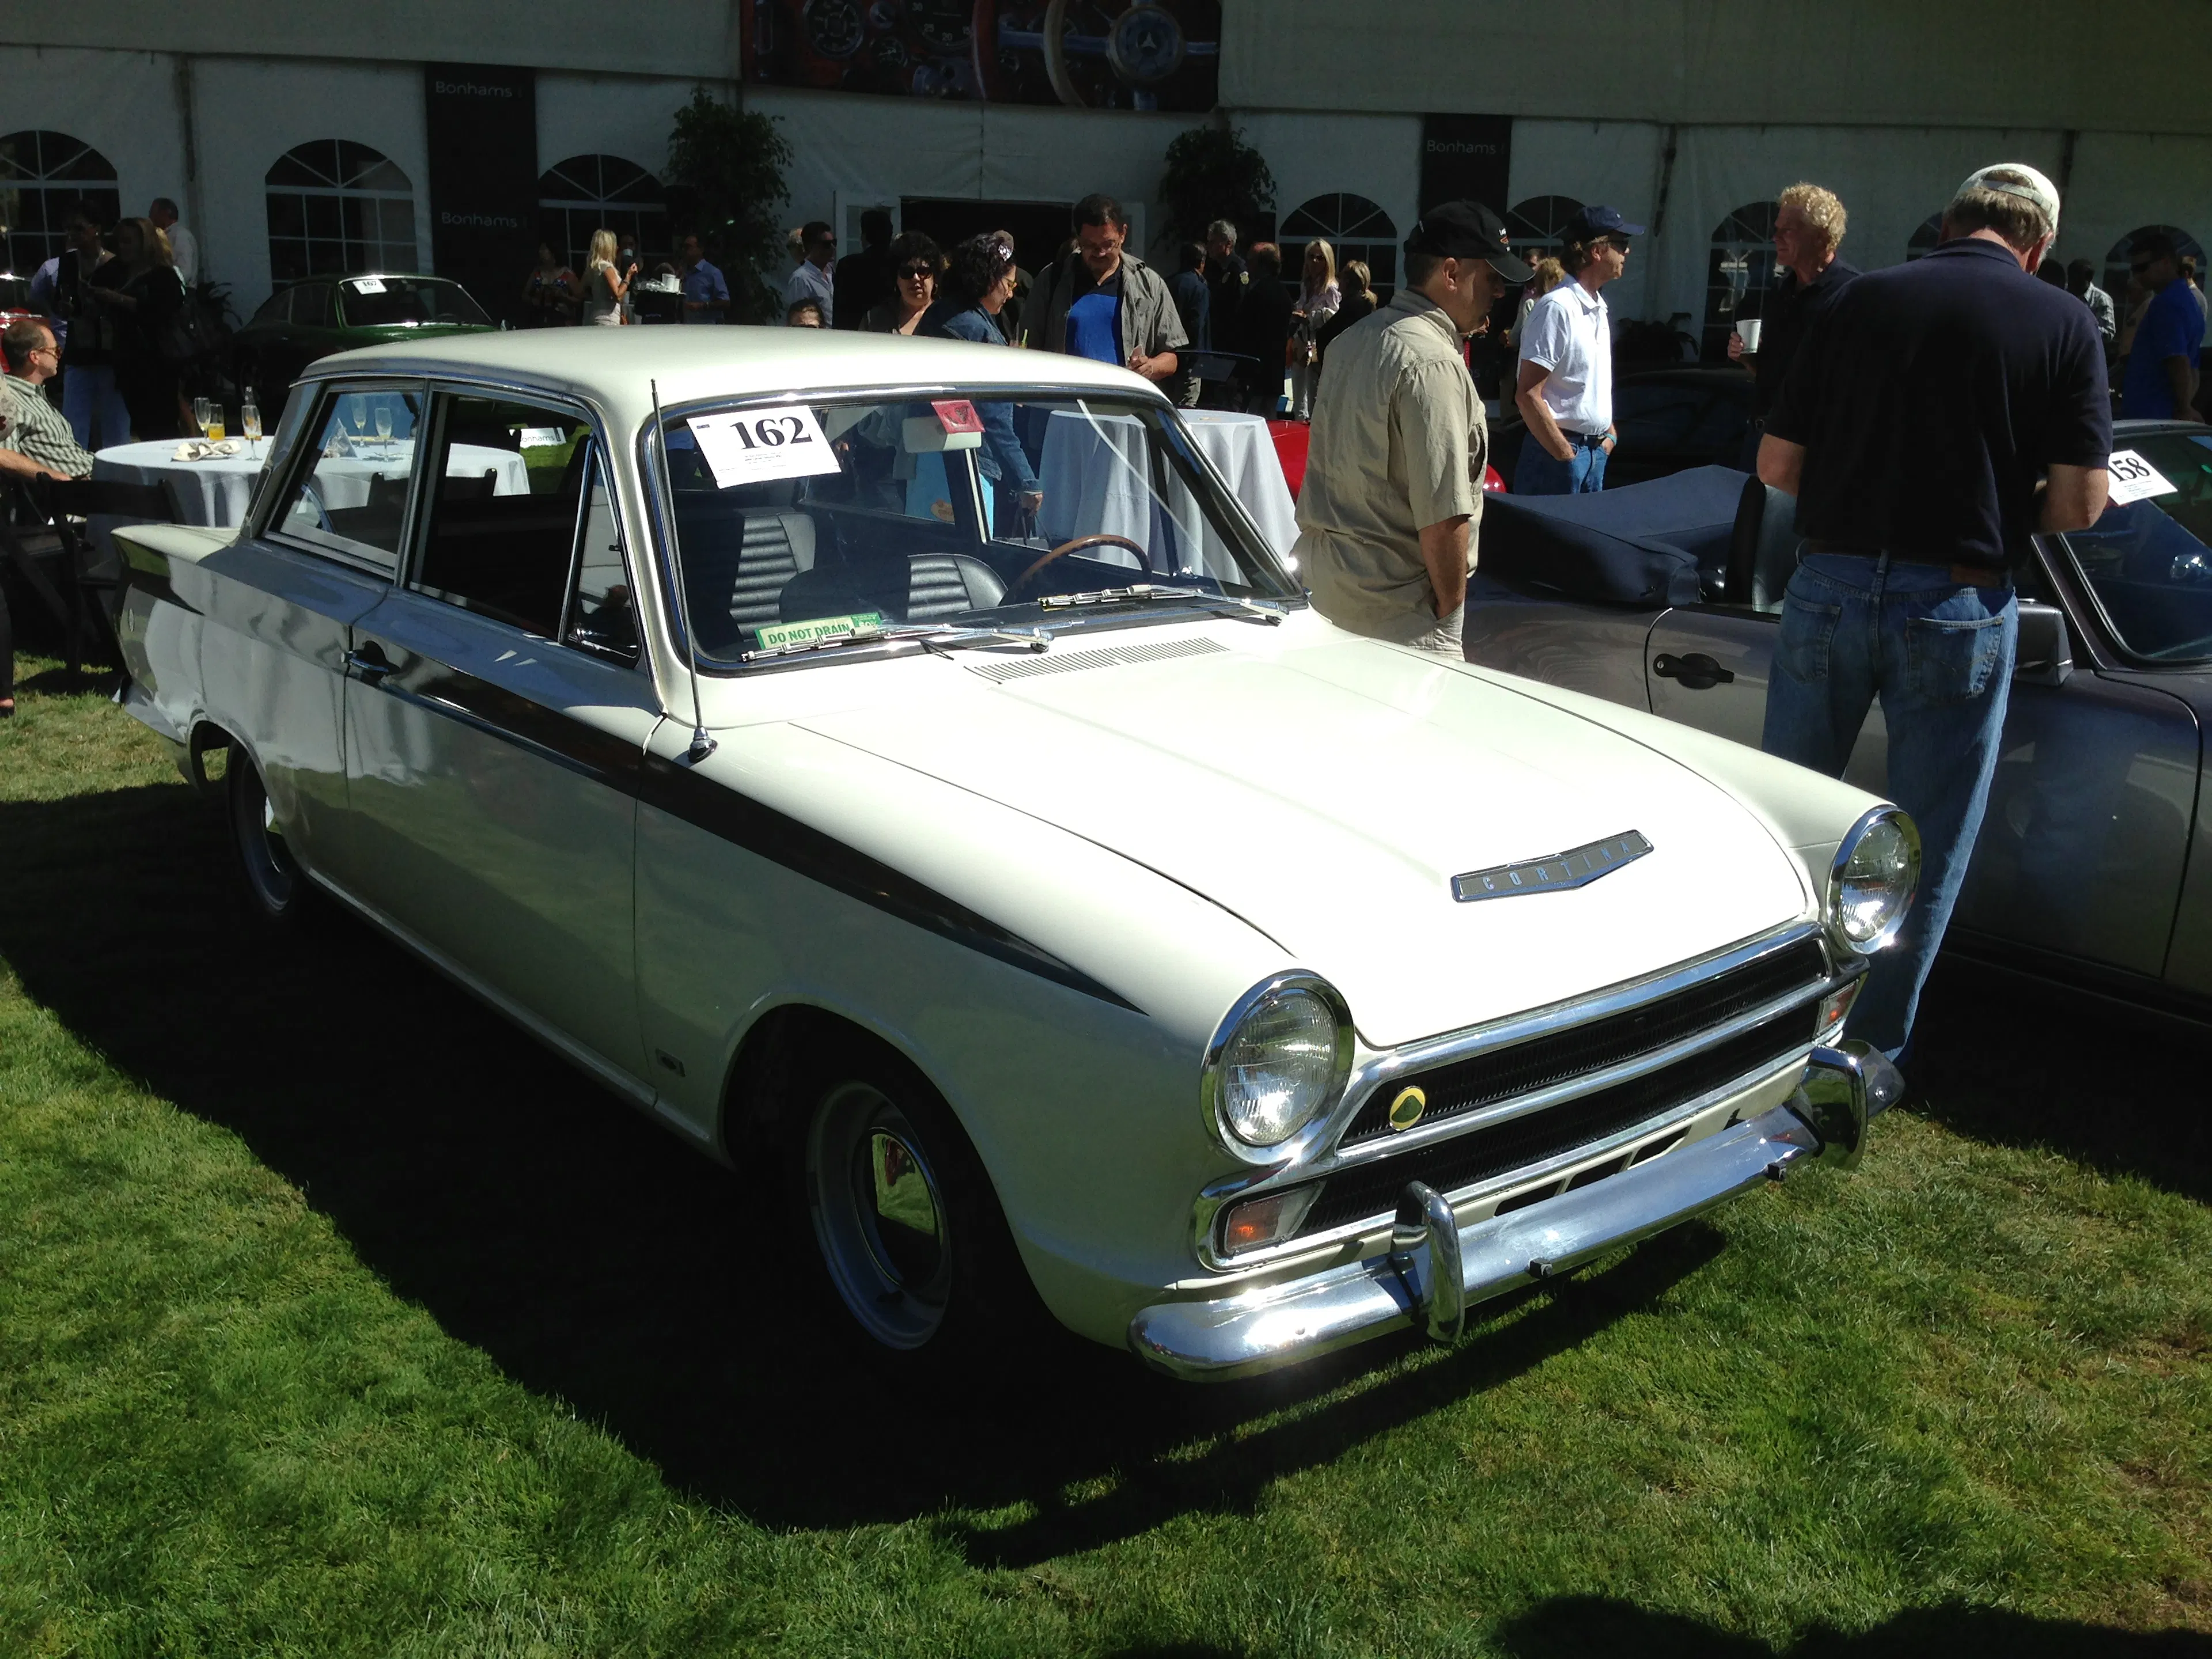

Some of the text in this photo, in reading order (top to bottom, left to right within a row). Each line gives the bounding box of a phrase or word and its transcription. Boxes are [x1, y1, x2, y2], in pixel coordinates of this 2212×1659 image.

[942, 32, 953, 41] 20
[435, 80, 513, 98] Bonhams
[1426, 139, 1497, 155] Bonhams
[441, 211, 518, 228] Bonhams
[729, 416, 813, 450] 162
[2108, 457, 2150, 482] 158
[768, 623, 850, 645] DO NOT DRAIN
[1482, 840, 1631, 891] CORTINA
